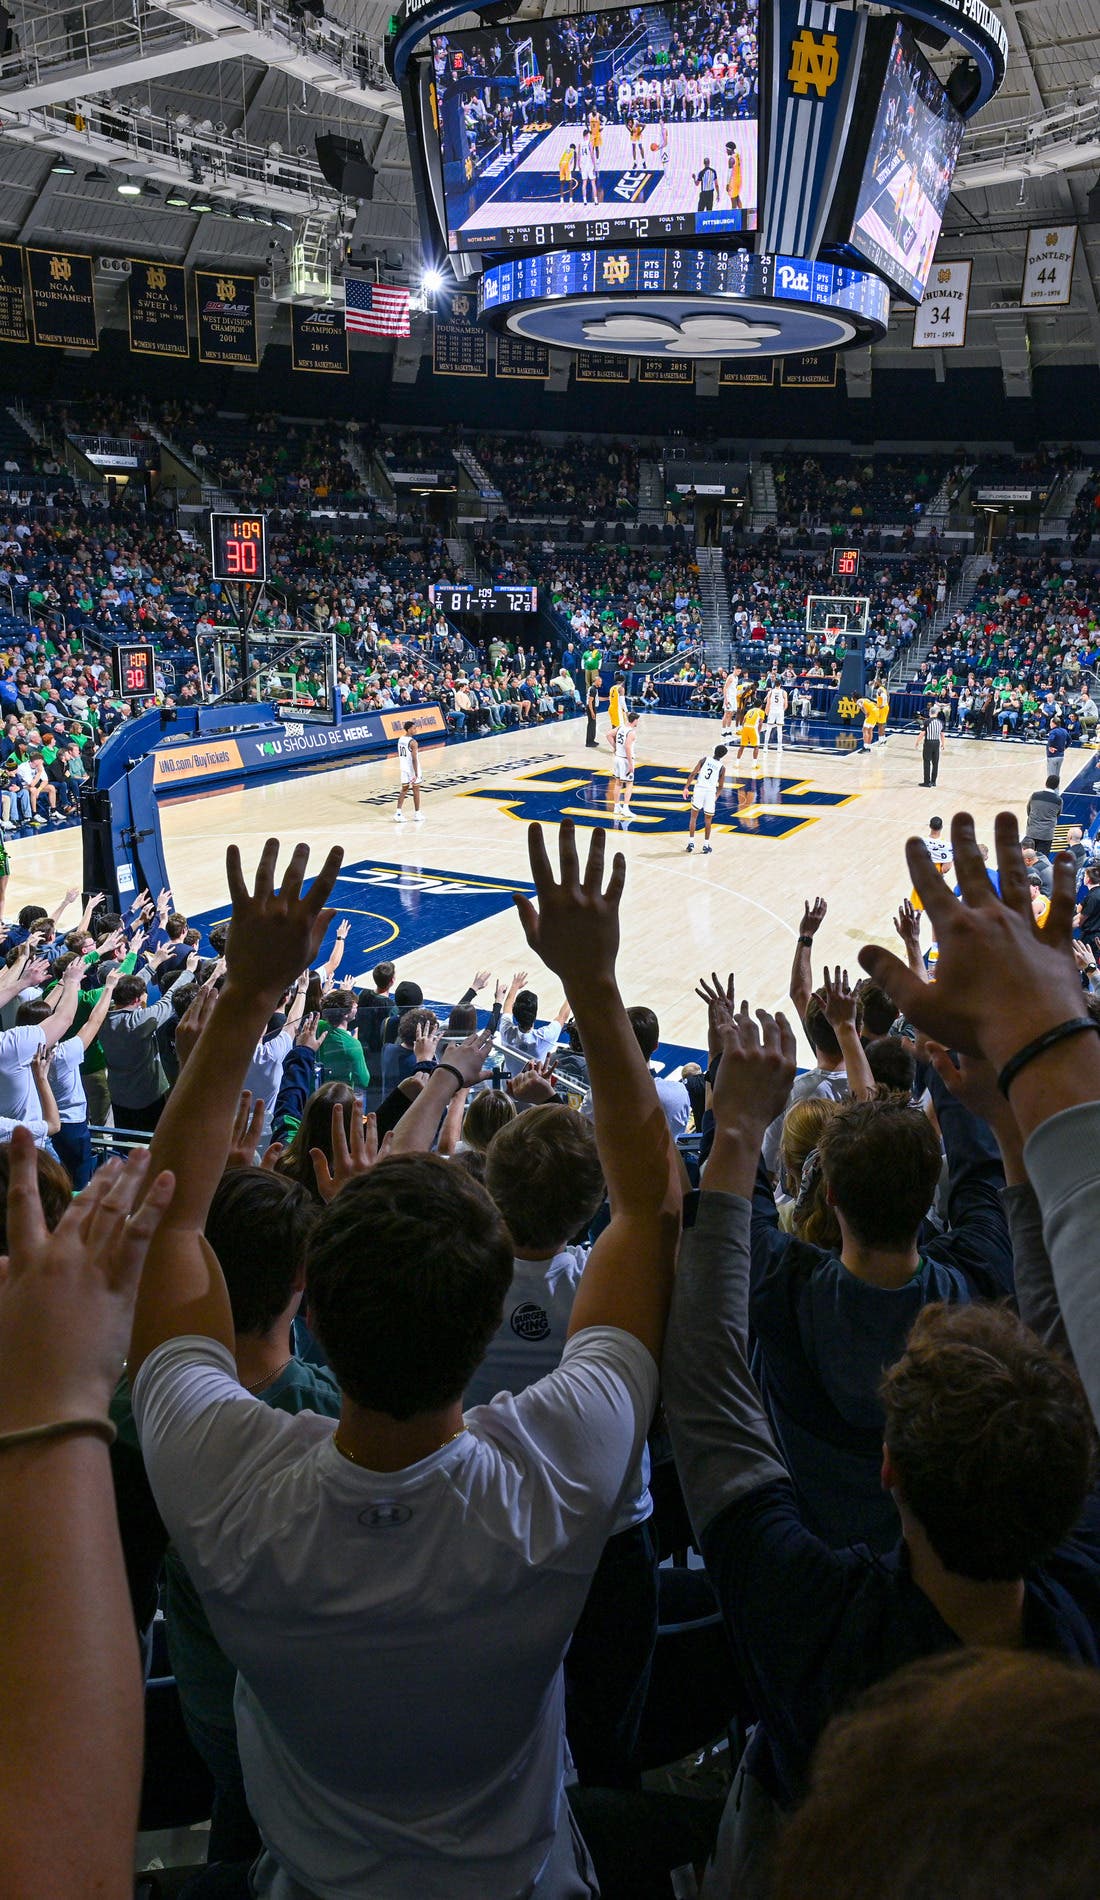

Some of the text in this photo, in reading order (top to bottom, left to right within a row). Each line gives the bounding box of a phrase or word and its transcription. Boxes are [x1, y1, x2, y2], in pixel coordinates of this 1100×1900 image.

[614, 171, 646, 200] ACC
[702, 218, 734, 226] PITTSBURGH
[586, 222, 610, 236] 1:09
[630, 218, 648, 238] 72
[536, 226, 554, 244] 81
[532, 253, 591, 267] 2 11 22 33
[674, 251, 772, 265] 3 5 10 14 25
[1028, 251, 1072, 266] DANTLEY
[518, 272, 524, 280] 15
[530, 269, 537, 277] 15
[546, 266, 553, 275] 14
[563, 265, 570, 273] 19
[584, 263, 588, 271] 7
[672, 260, 682, 268] 10
[696, 262, 704, 270] 17
[717, 263, 727, 271] 20
[739, 264, 748, 272] 14
[530, 279, 537, 287] 12
[583, 274, 588, 282] 6
[644, 271, 660, 279] REB
[696, 272, 702, 280] 4
[741, 274, 746, 282] 7
[762, 276, 767, 284] 0
[778, 265, 810, 291] Pitt
[818, 274, 828, 283] PTS
[1037, 267, 1056, 284] 44
[50, 282, 75, 292] NCAA
[564, 285, 568, 293] 3
[582, 284, 588, 292] 4
[672, 282, 678, 290] 4
[696, 282, 702, 290] 3
[740, 284, 746, 292] 2
[816, 284, 828, 292] REB
[34, 289, 92, 303] TOURNAMENT
[146, 291, 170, 301] NCAA
[816, 294, 828, 302] FLS
[922, 289, 964, 302] SHUMATE
[138, 299, 166, 310] SWEET
[224, 304, 250, 312] EAST
[202, 315, 252, 326] WEST DIVISION
[306, 312, 336, 322] ACC
[930, 306, 950, 324] 34
[450, 318, 470, 326] NCAA
[210, 324, 245, 334] CHAMPION
[300, 325, 342, 334] CHAMPIONS
[437, 325, 484, 334] TOURNAMENT
[38, 333, 96, 346] WOMEN'S VOLLEYBALL
[220, 334, 238, 344] 2001
[157, 342, 186, 352] VOLLEYBALL
[312, 343, 330, 352] 2015
[206, 351, 252, 362] MEN'S BASKETBALL
[801, 358, 818, 366] 1978
[298, 360, 342, 369] MEN'S BASKETBALL
[454, 364, 482, 372] BASKETBALL
[502, 366, 516, 374] MEN'S
[671, 363, 688, 371] 2015
[660, 372, 688, 380] BASKETBALL
[740, 374, 768, 382] BASKETBALL
[233, 522, 260, 540] 1:09
[226, 540, 256, 573] 30
[838, 559, 854, 573] 30
[478, 588, 492, 598] 1:09
[452, 594, 471, 610] 81
[507, 594, 524, 611] 72
[130, 652, 147, 668] 1:09
[126, 670, 145, 689] 30
[774, 696, 780, 704] 5
[283, 733, 328, 752] SHOULD
[329, 730, 344, 744] BE
[344, 726, 373, 742] HERE.
[617, 733, 624, 745] 25
[399, 746, 408, 757] 10
[158, 752, 230, 773] UND.com/BuyTickets
[704, 768, 714, 780] 3
[514, 1311, 547, 1324] BURGER
[517, 1318, 549, 1334] KING
